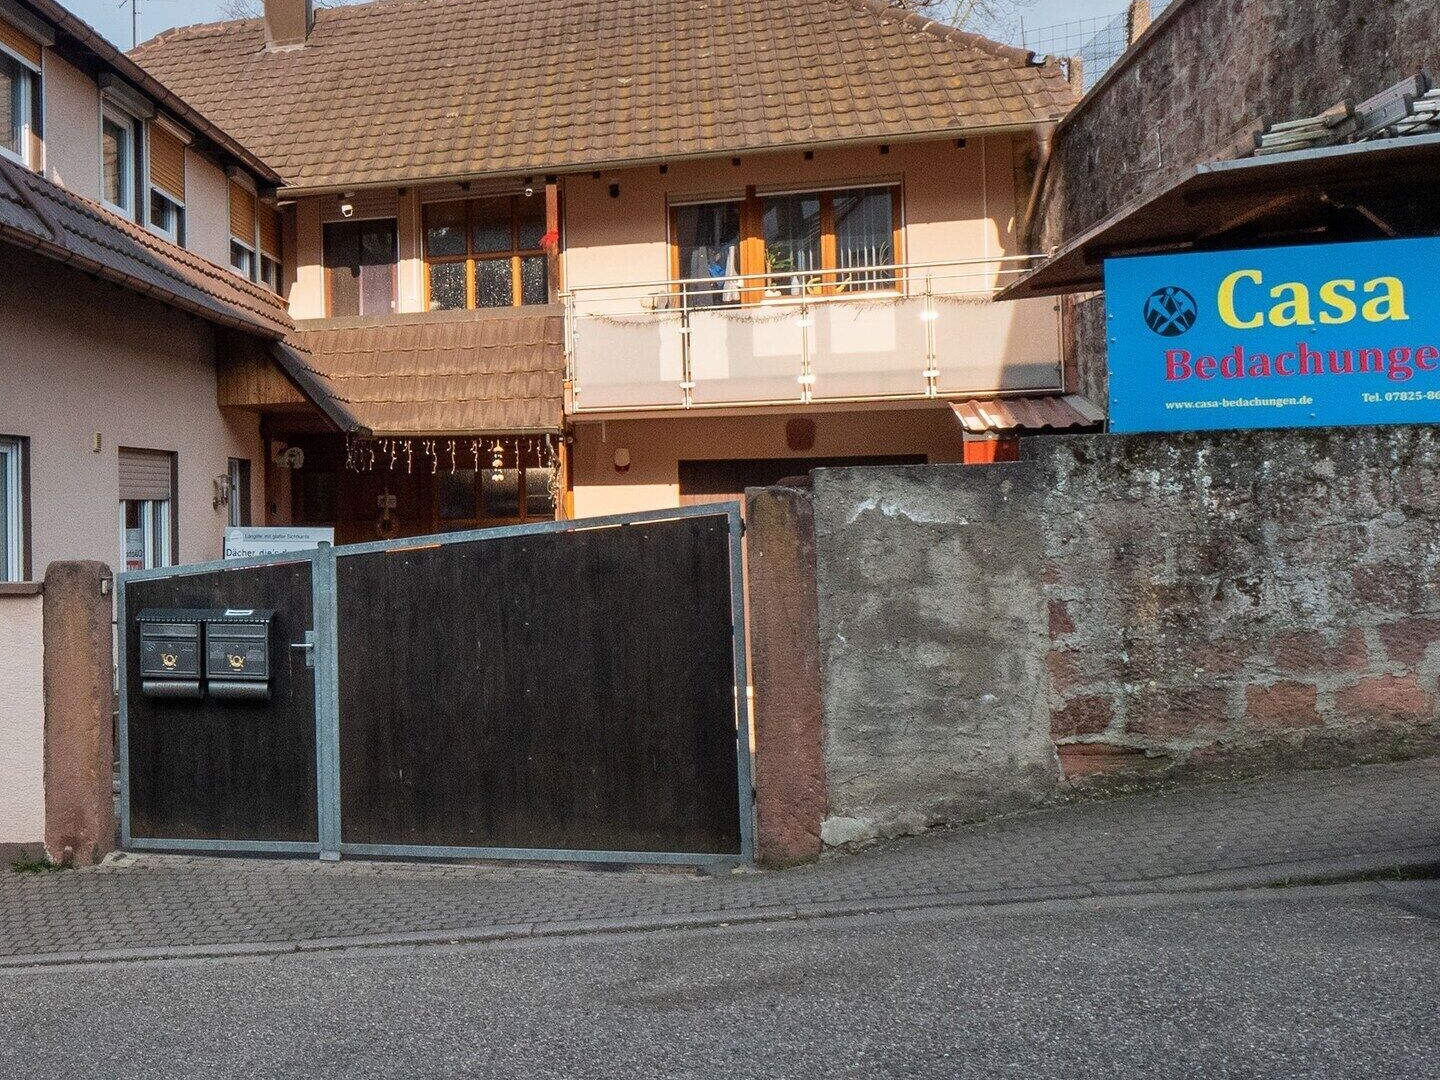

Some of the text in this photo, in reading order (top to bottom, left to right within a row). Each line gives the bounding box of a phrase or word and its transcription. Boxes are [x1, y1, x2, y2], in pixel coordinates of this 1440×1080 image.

[1217, 269, 1409, 329] Casa
[1165, 395, 1313, 409] www.casa-bedachungen.de
[1362, 392, 1382, 403] Tel.
